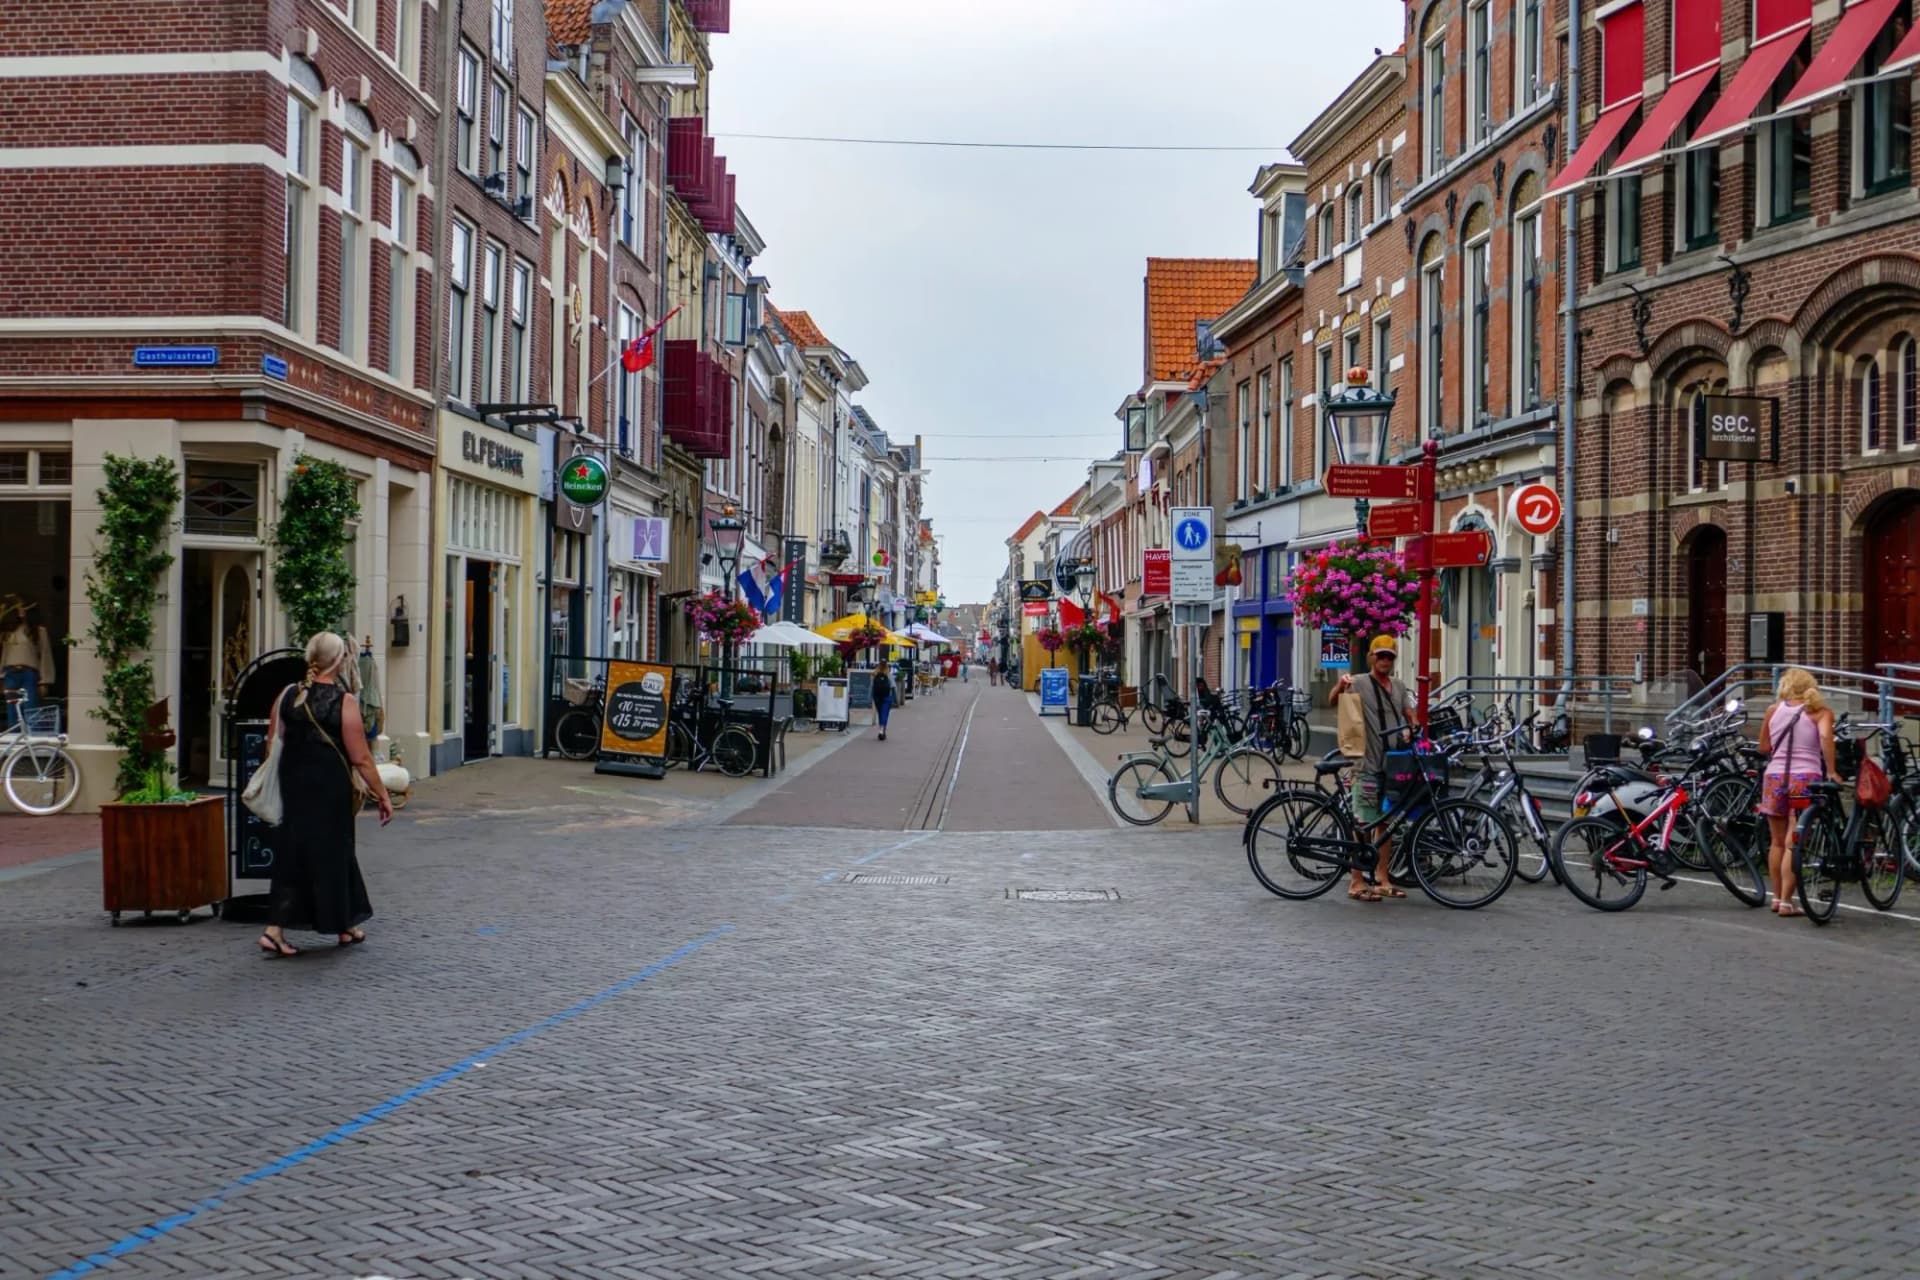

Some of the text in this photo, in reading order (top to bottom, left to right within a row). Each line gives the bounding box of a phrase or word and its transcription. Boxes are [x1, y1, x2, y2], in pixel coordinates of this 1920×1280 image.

[139, 351, 212, 361] Gasthuisstraat
[1711, 414, 1756, 433] sec.
[1711, 434, 1756, 442] architecten
[563, 481, 603, 491] Heineken
[1321, 643, 1349, 662] alex
